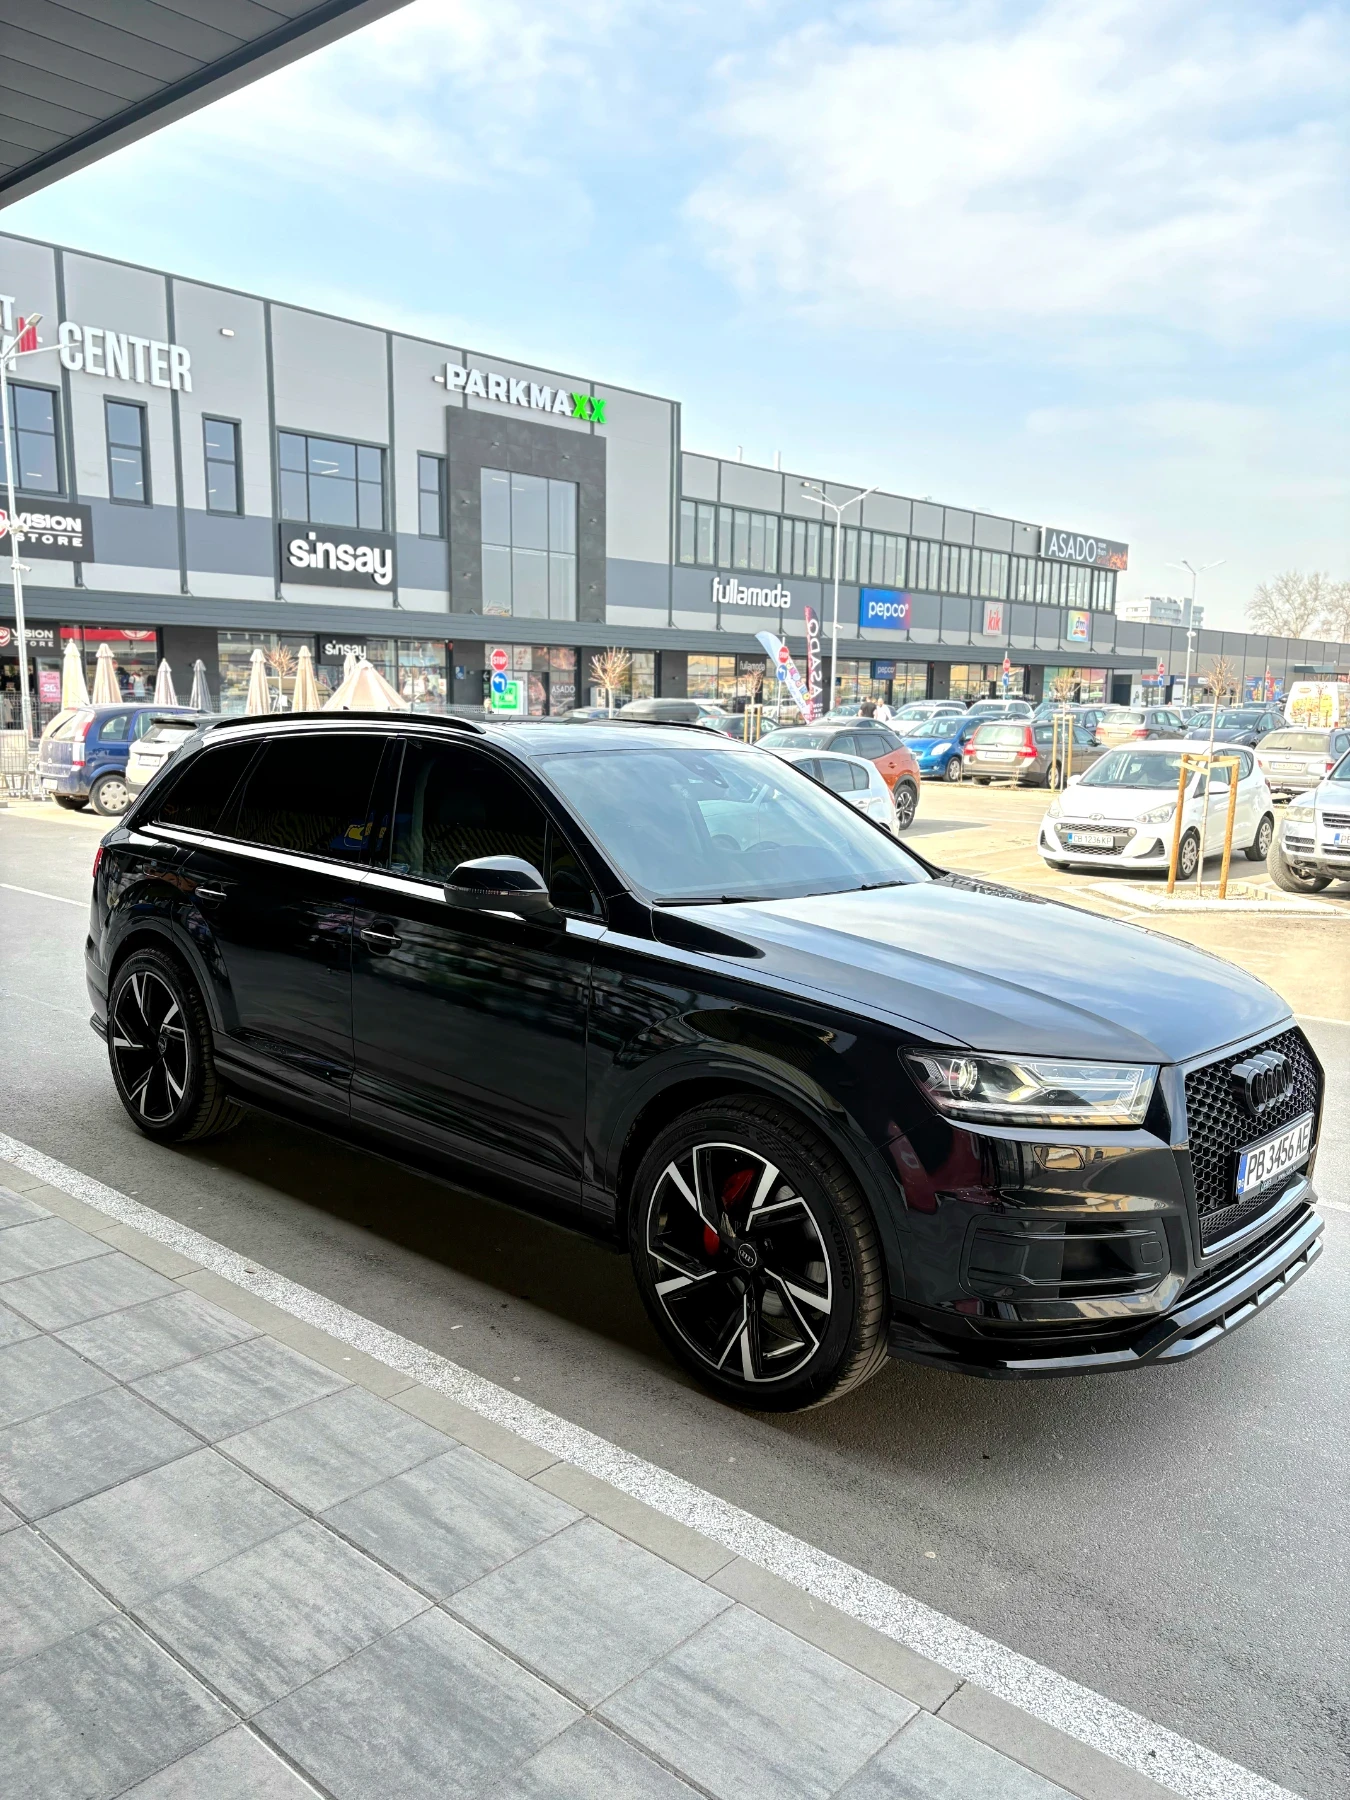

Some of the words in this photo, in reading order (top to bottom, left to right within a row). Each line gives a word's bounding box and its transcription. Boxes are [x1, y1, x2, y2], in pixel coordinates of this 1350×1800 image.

[58, 321, 193, 393] CENTER
[445, 362, 607, 424] PARKMAXX
[15, 532, 83, 547] STORE
[1048, 531, 1097, 563] ASADO
[289, 531, 393, 586] sinsay
[712, 577, 791, 608] fullamoda
[868, 601, 906, 619] pepco
[1075, 616, 1086, 629] dm
[11, 628, 54, 639] VSION
[324, 640, 367, 660] sinsay
[492, 656, 507, 665] STOP
[739, 661, 766, 671] fullamoda
[551, 685, 576, 694] ASADO
[1246, 1149, 1266, 1186] PB
[1266, 1132, 1295, 1175] 3456
[1295, 1122, 1311, 1158] AE
[828, 1219, 851, 1290] KUMHO
